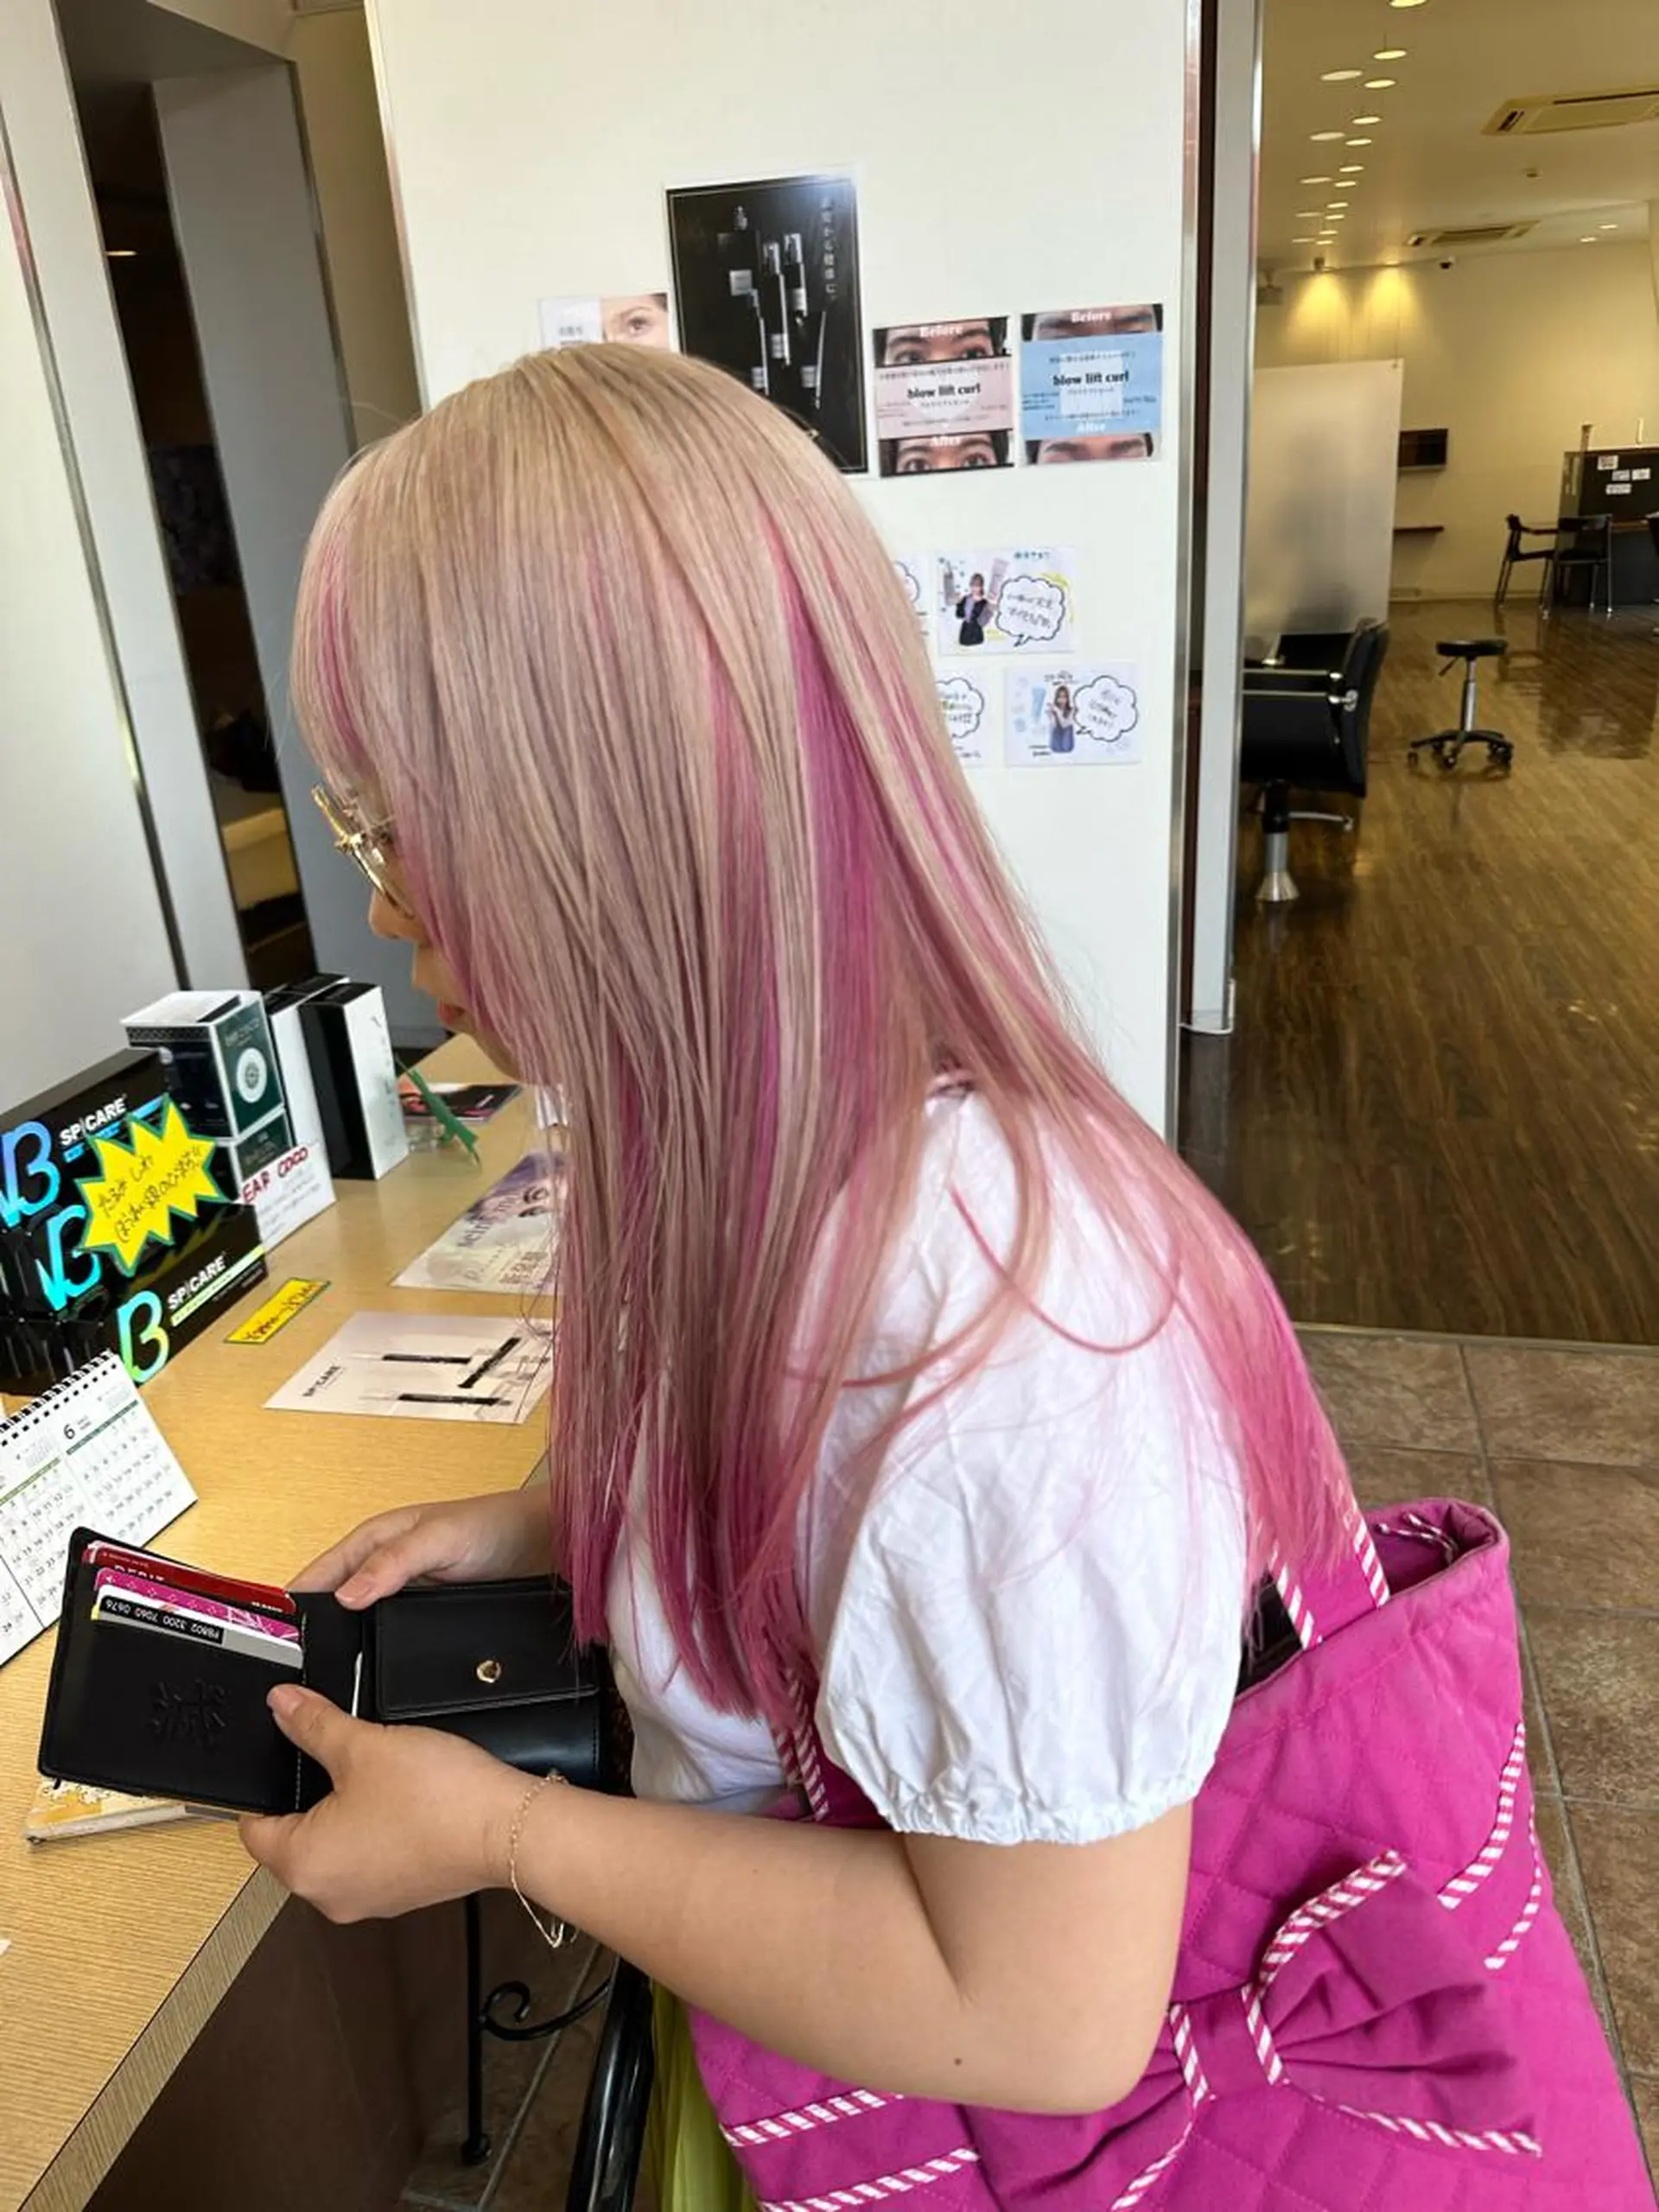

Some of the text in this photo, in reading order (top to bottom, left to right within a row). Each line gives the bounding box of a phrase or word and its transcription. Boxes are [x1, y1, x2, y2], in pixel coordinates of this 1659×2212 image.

[1070, 310, 1112, 323] Before
[918, 324, 963, 339] Before
[1052, 370, 1129, 386] blow lift curl
[907, 383, 981, 399] blow lift curl
[1077, 421, 1106, 433] After
[929, 435, 961, 448] After
[63, 1423, 76, 1440] 6
